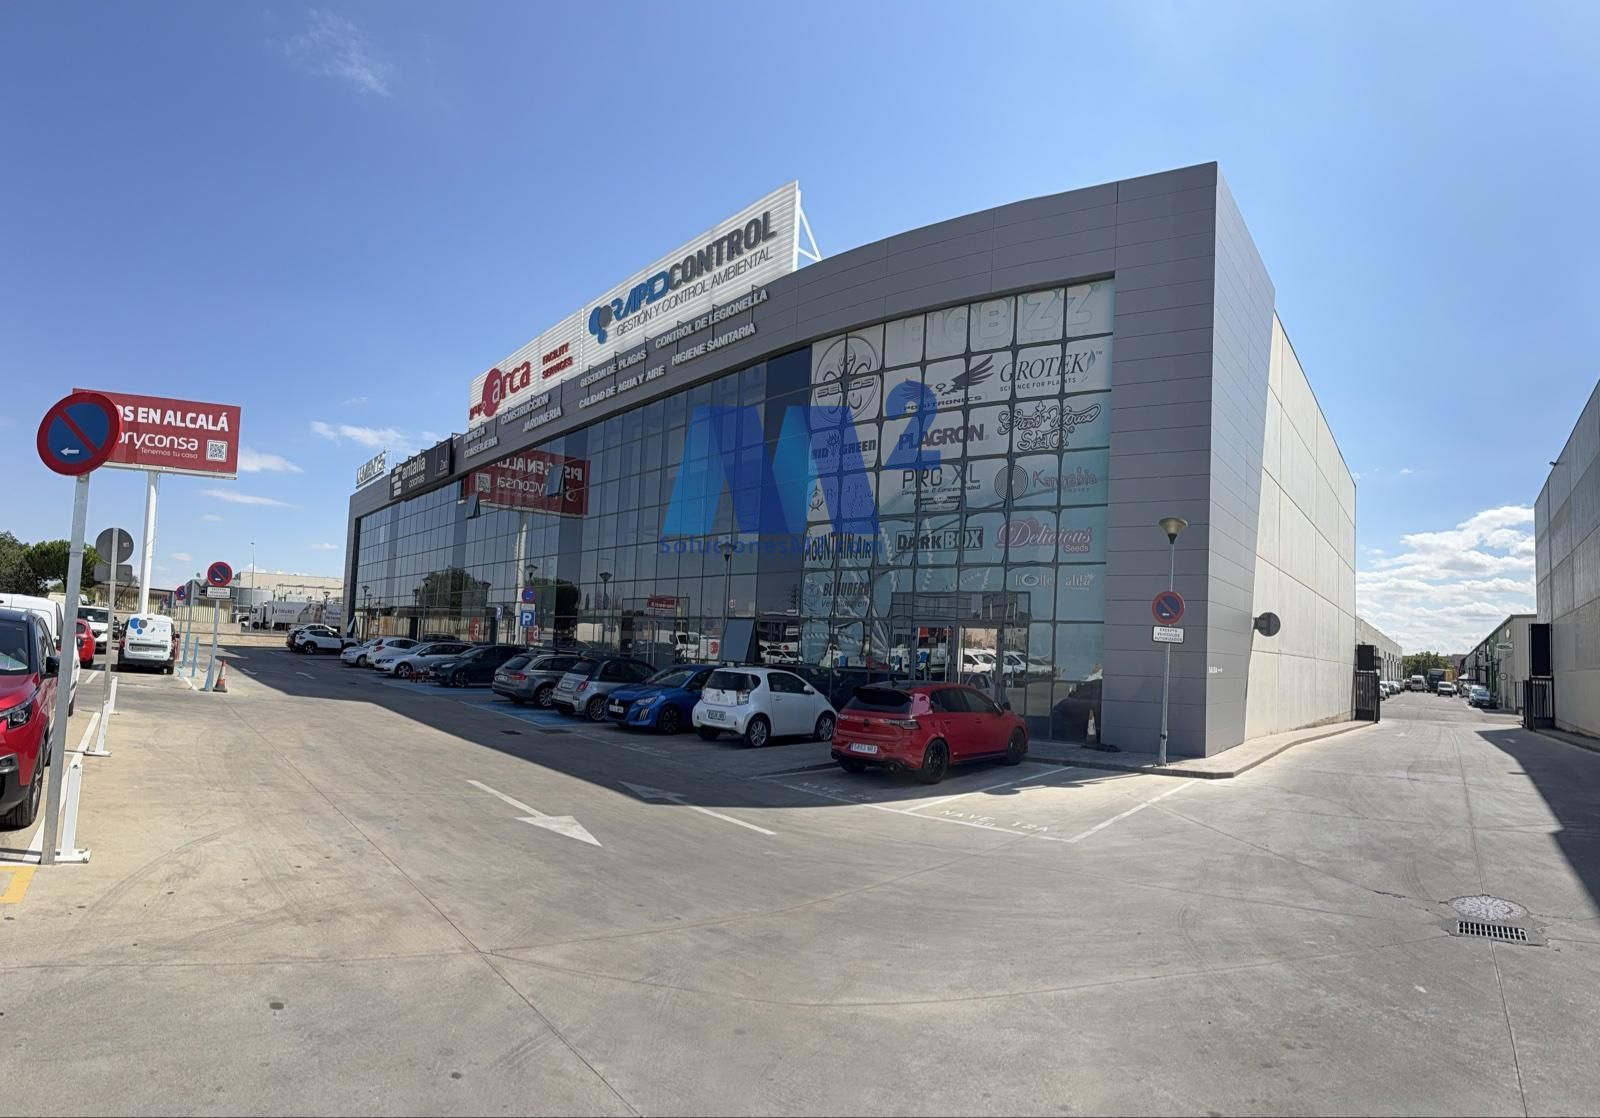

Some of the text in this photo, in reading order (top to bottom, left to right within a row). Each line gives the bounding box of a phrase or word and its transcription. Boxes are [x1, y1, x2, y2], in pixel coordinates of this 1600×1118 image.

[616, 247, 773, 336] GESTIÓN Y CONTROL AMBIENTAL
[655, 289, 768, 348] CONTROL DE LEGIONELLA
[542, 342, 569, 365] FACILITY
[671, 323, 756, 366] HIGIENE SANITARIA
[542, 356, 573, 379] SERVICES
[580, 349, 647, 388] GESTION DE PLAGAS
[1000, 352, 1089, 383] GROTEK
[578, 390, 606, 409] CALIDAD
[605, 386, 617, 398] DE
[617, 376, 638, 393] AGUA
[645, 364, 665, 382] AIRE
[999, 382, 1030, 392] SCINCE
[1032, 380, 1045, 388] FOR
[137, 406, 162, 425] EN
[163, 411, 229, 432] ALCALÁ
[500, 392, 550, 425] CONSTRUCCION
[522, 405, 562, 433] JARDINERIA
[899, 423, 984, 451] PLAGRON
[141, 447, 198, 459] Tenemos tu casa
[902, 463, 980, 489] PRO XL
[898, 530, 982, 550] DARK BOX
[996, 519, 1092, 547] Delicious
[1065, 544, 1089, 552] Seeds
[522, 612, 532, 625] P
